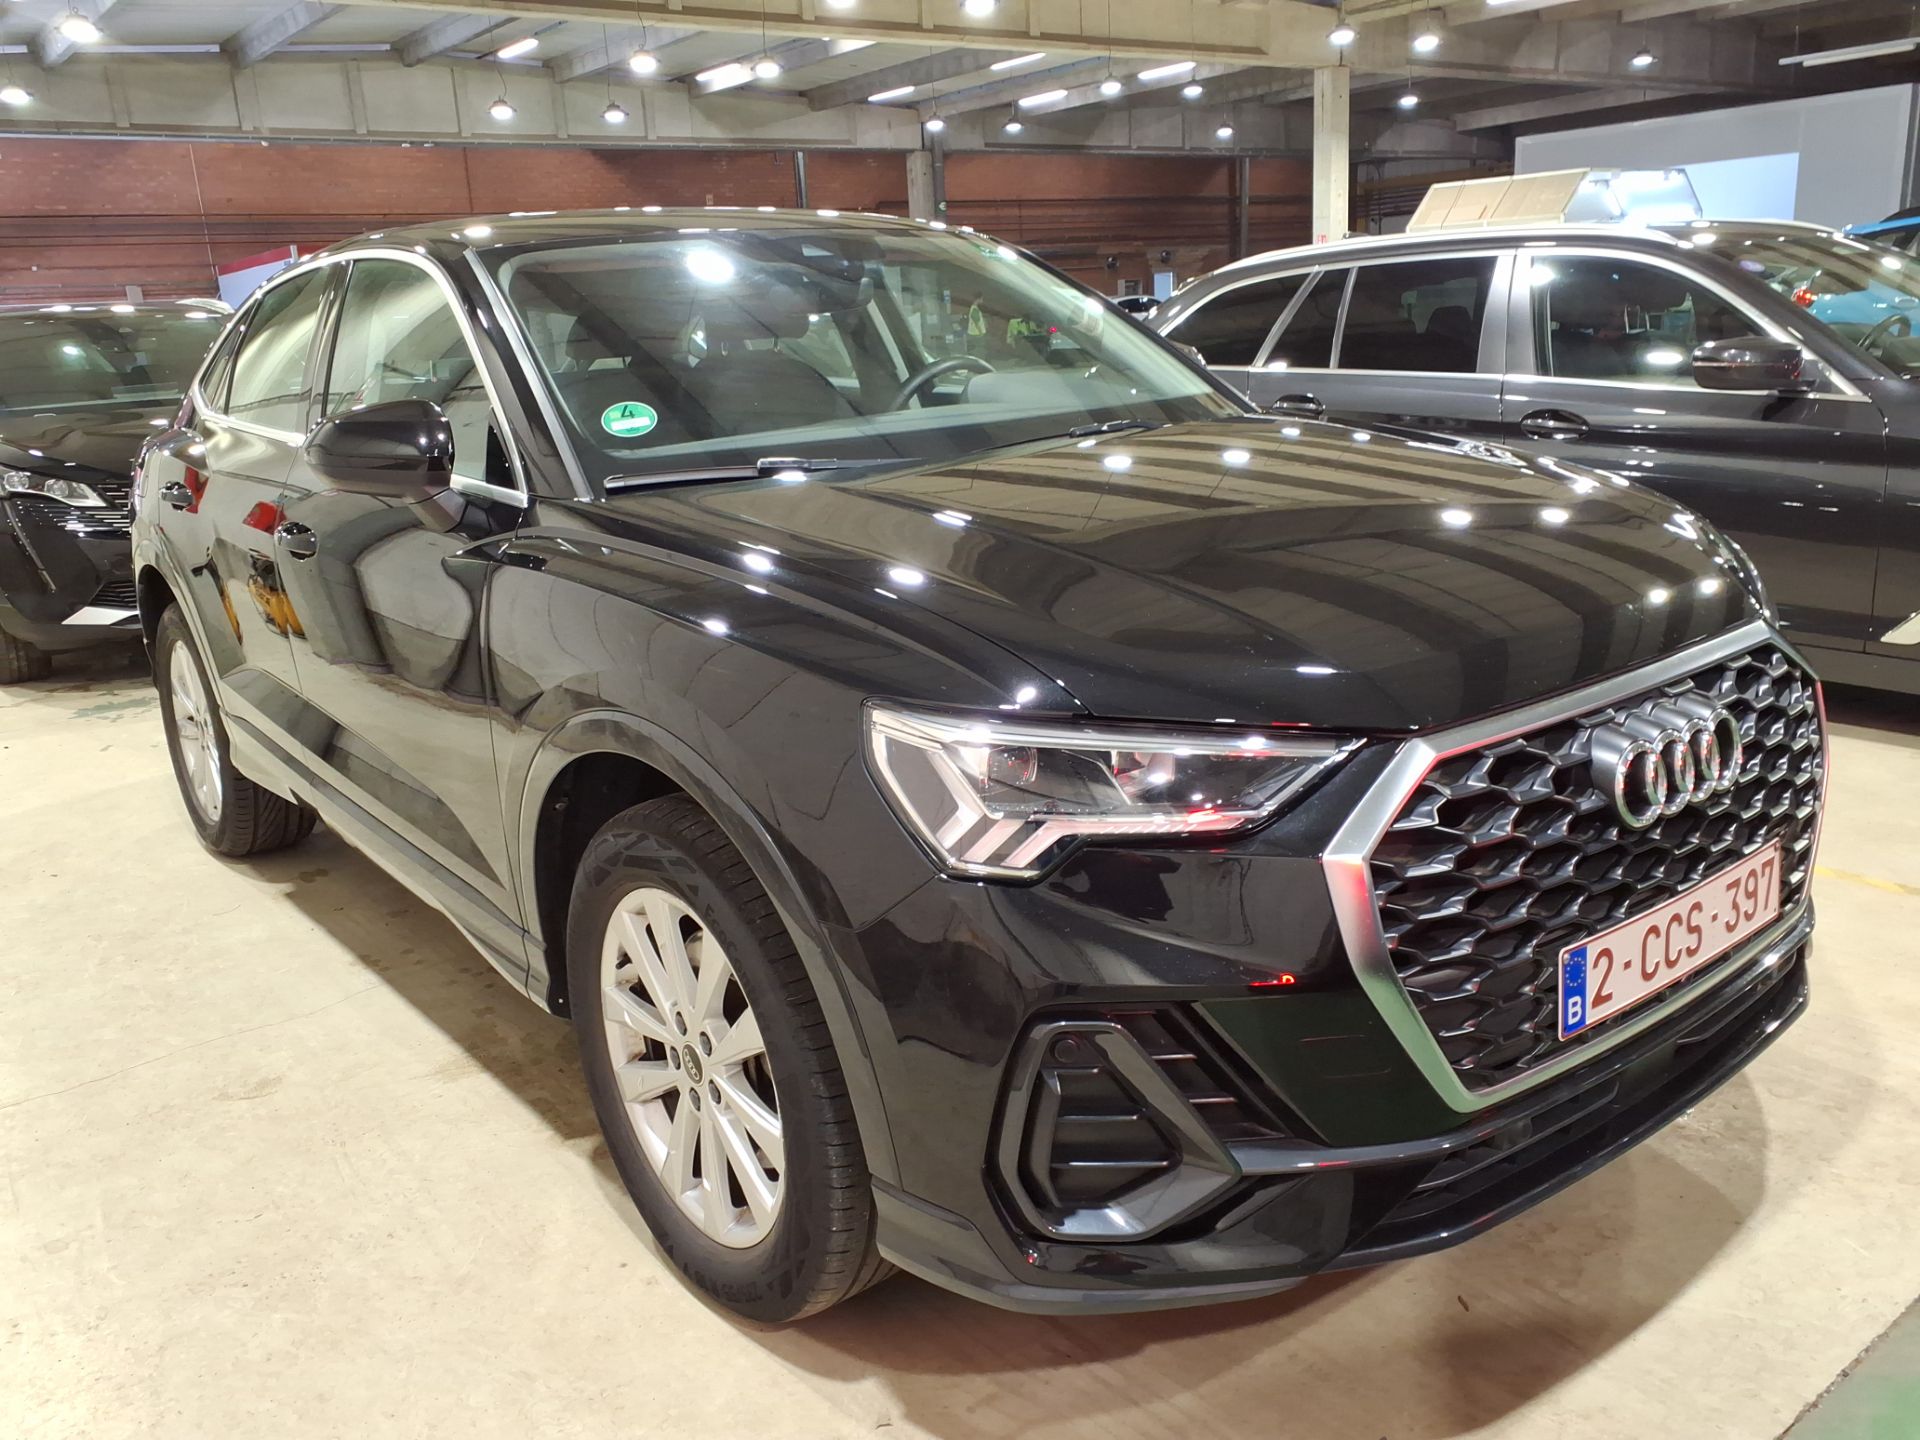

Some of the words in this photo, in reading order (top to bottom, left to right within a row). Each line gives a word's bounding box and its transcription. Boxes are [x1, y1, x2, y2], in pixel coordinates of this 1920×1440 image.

[621, 404, 635, 418] 4
[1591, 855, 1775, 1009] 2-CCS-397
[1567, 995, 1582, 1025] B
